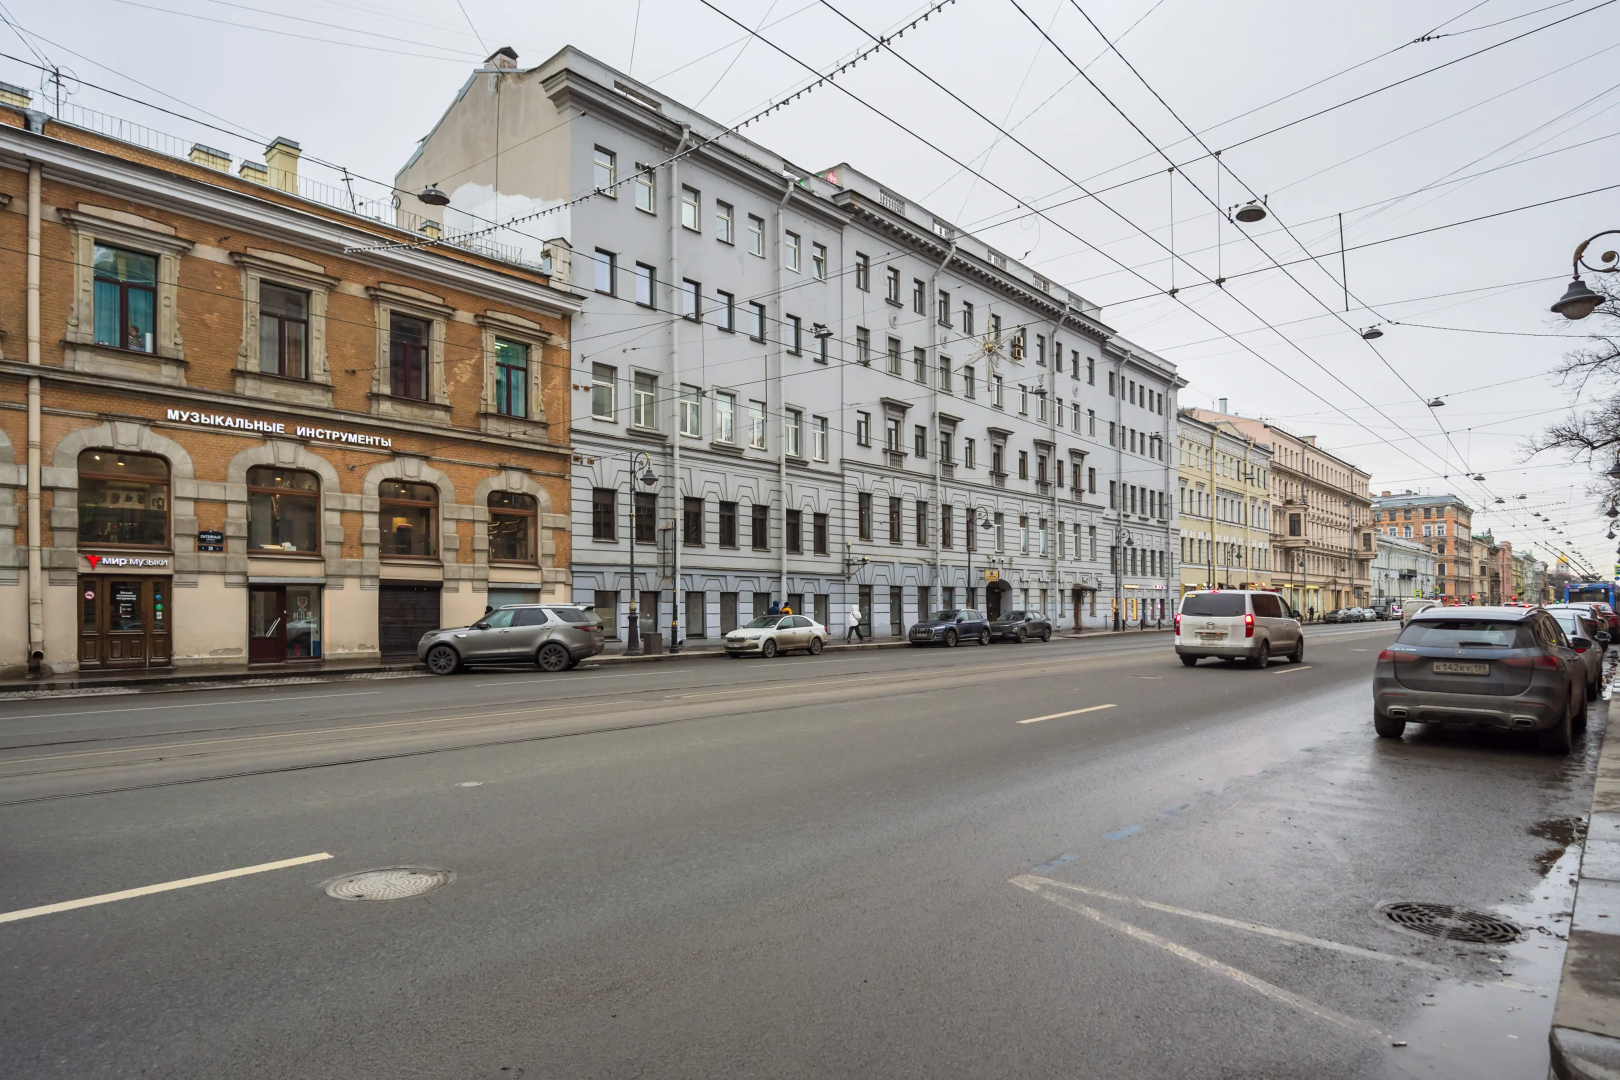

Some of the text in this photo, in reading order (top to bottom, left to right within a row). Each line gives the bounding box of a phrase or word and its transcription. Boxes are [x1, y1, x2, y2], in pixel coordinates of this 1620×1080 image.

[167, 408, 392, 447] МУЗЫКАЛЬНЫЕ ИНСТРУМЕНТЫ
[102, 557, 168, 567] мир музыки
